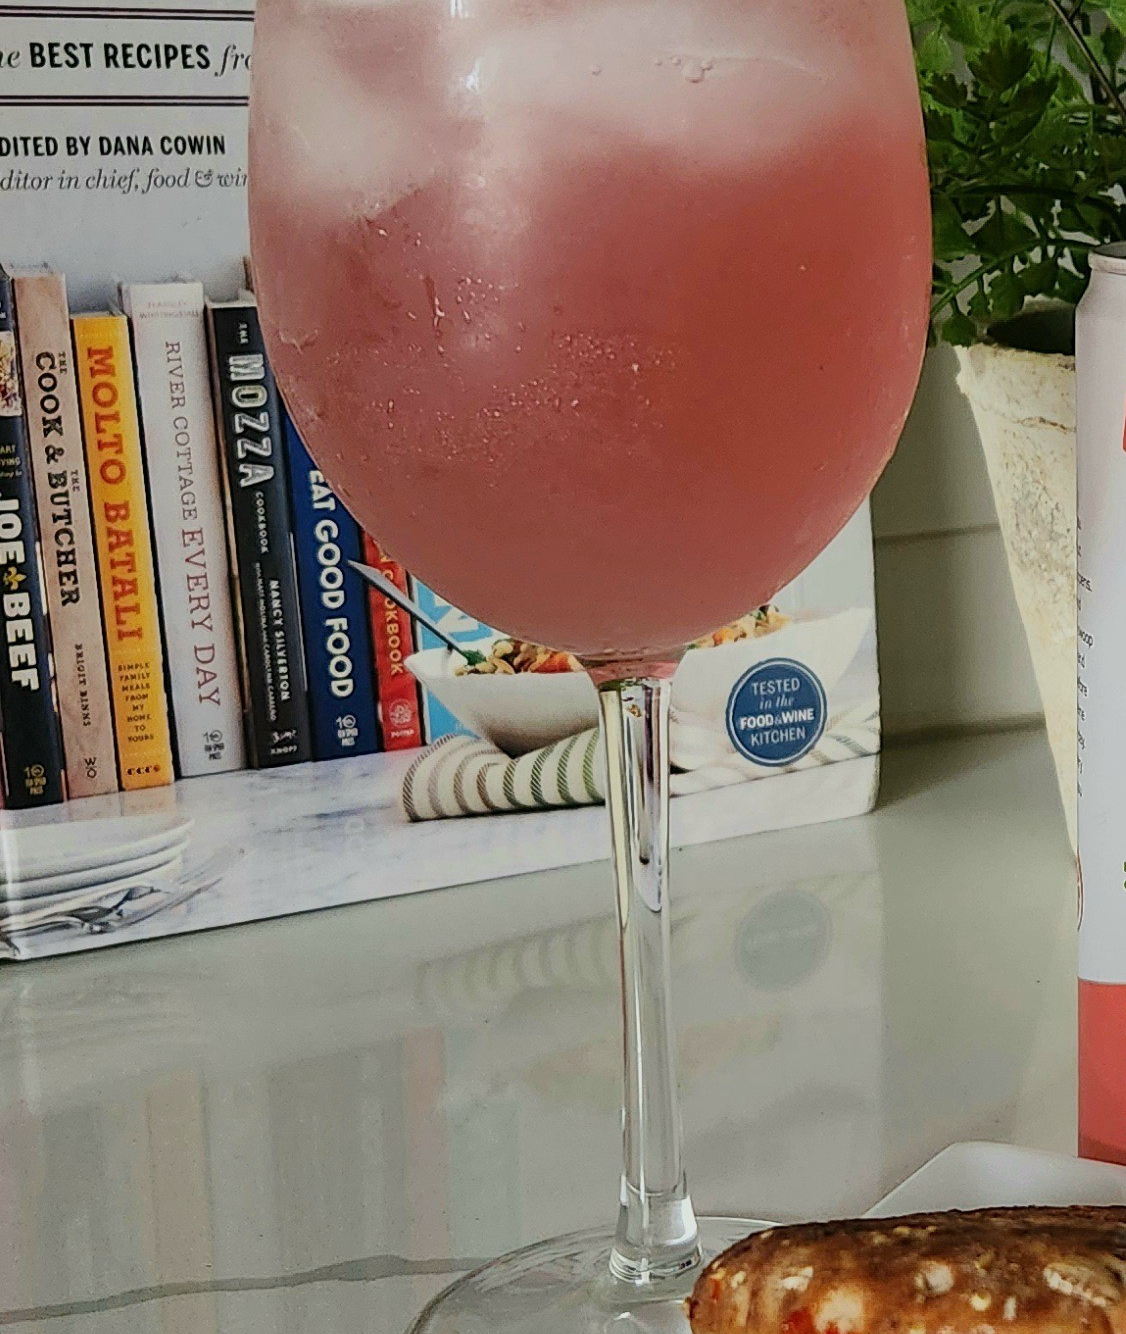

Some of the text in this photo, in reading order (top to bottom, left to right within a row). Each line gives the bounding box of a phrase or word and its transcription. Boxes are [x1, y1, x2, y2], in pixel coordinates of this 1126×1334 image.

[29, 42, 94, 69] BEST
[103, 43, 211, 70] RECIPES
[58, 170, 81, 190] in
[85, 168, 140, 194] chief,
[141, 167, 191, 195] food
[66, 136, 91, 156] BY
[98, 135, 154, 156] DANA
[160, 134, 227, 156] COWIN
[35, 351, 64, 438] COOK
[165, 341, 187, 409] RIVER
[228, 353, 275, 488] MOZZA
[87, 346, 143, 642] MOLTO BATALI
[172, 417, 198, 521] COTTAGE
[48, 470, 80, 607] BUTCHER
[314, 519, 346, 609] GOOD
[181, 527, 213, 632] EVERY
[269, 579, 284, 627] NANCY
[4, 593, 40, 691] BEEF
[194, 643, 222, 707] DAY
[325, 618, 355, 698] FOOD
[751, 677, 801, 696] TESTED
[759, 693, 795, 709] in the
[751, 726, 806, 747] KITCHEN
